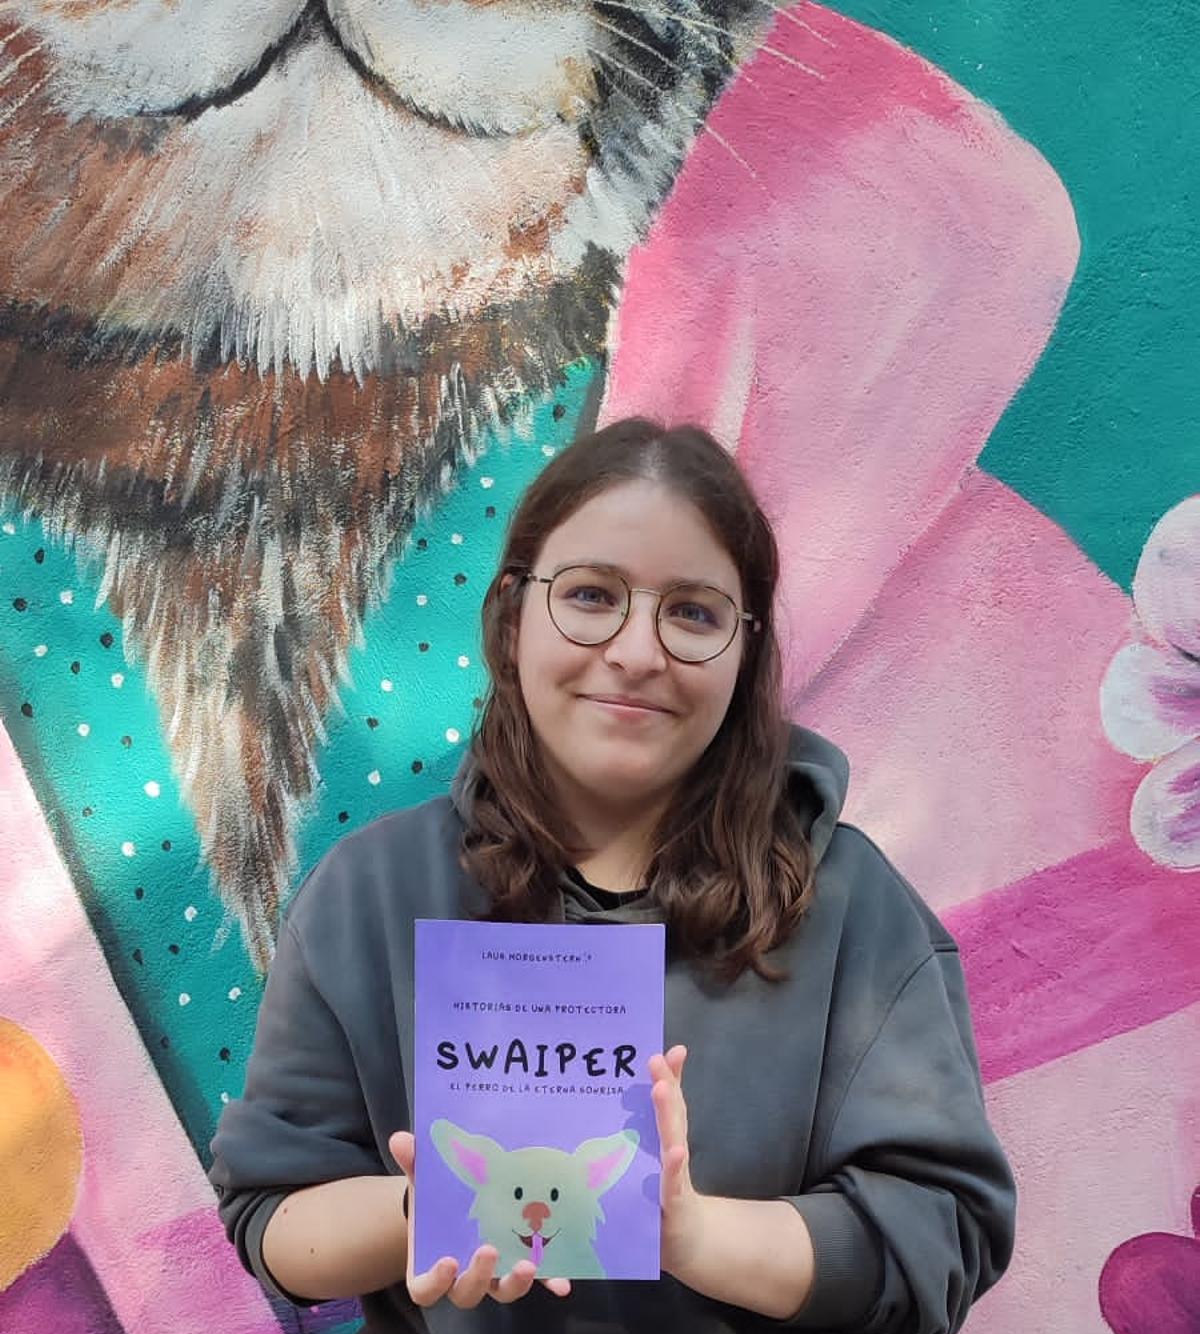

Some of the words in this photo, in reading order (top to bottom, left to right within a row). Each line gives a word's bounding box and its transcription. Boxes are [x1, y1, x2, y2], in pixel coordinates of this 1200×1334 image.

[453, 1001, 511, 1012] HISTORIAS
[515, 1003, 528, 1013] DE
[531, 1003, 551, 1013] UNA
[555, 1004, 626, 1015] PROTECTORA
[436, 1038, 637, 1078] SWAIPER
[450, 1082, 460, 1091] EL
[465, 1083, 499, 1092] PERRO
[502, 1085, 515, 1093] DE
[519, 1084, 530, 1093] LA
[534, 1085, 576, 1095] ETERNA
[579, 1086, 624, 1096] SONRISA
